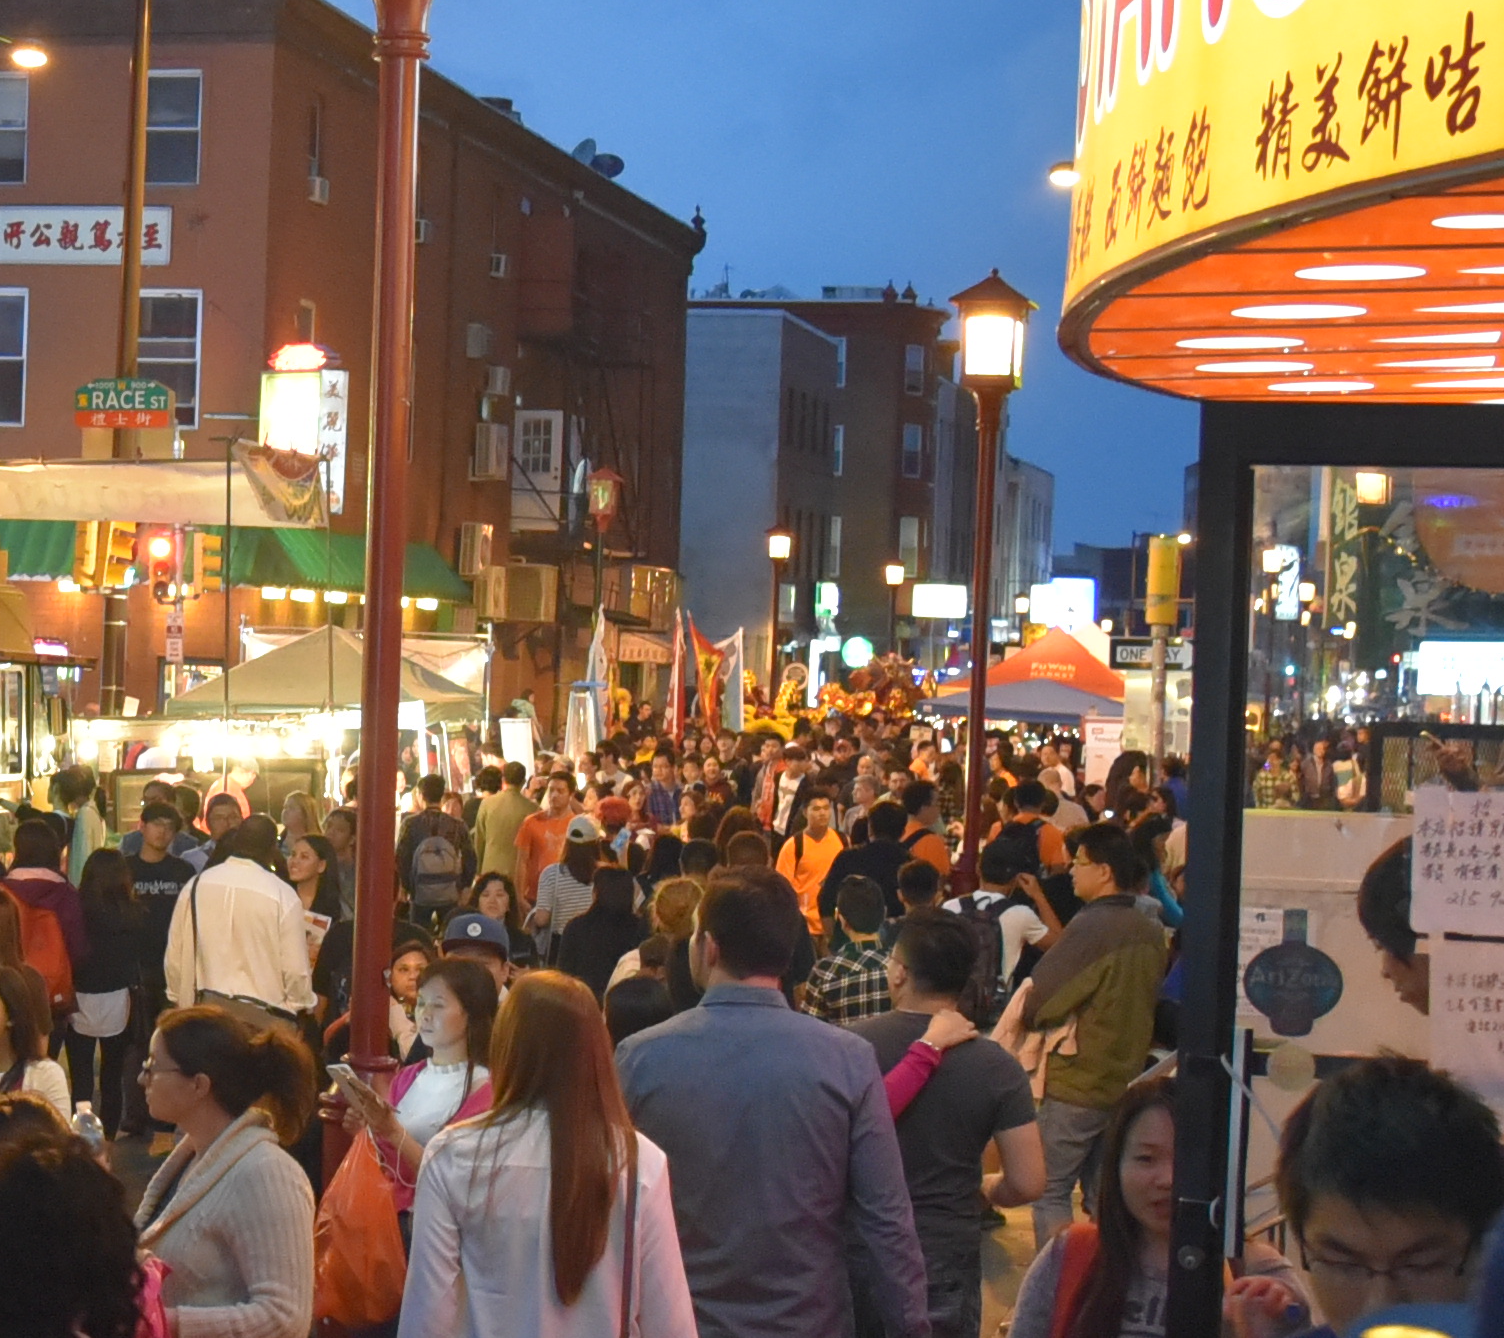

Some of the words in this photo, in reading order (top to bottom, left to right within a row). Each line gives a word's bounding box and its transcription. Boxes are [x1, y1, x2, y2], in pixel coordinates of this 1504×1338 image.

[92, 390, 146, 410] RACE
[150, 396, 167, 410] ST
[1119, 647, 1147, 662] ONE
